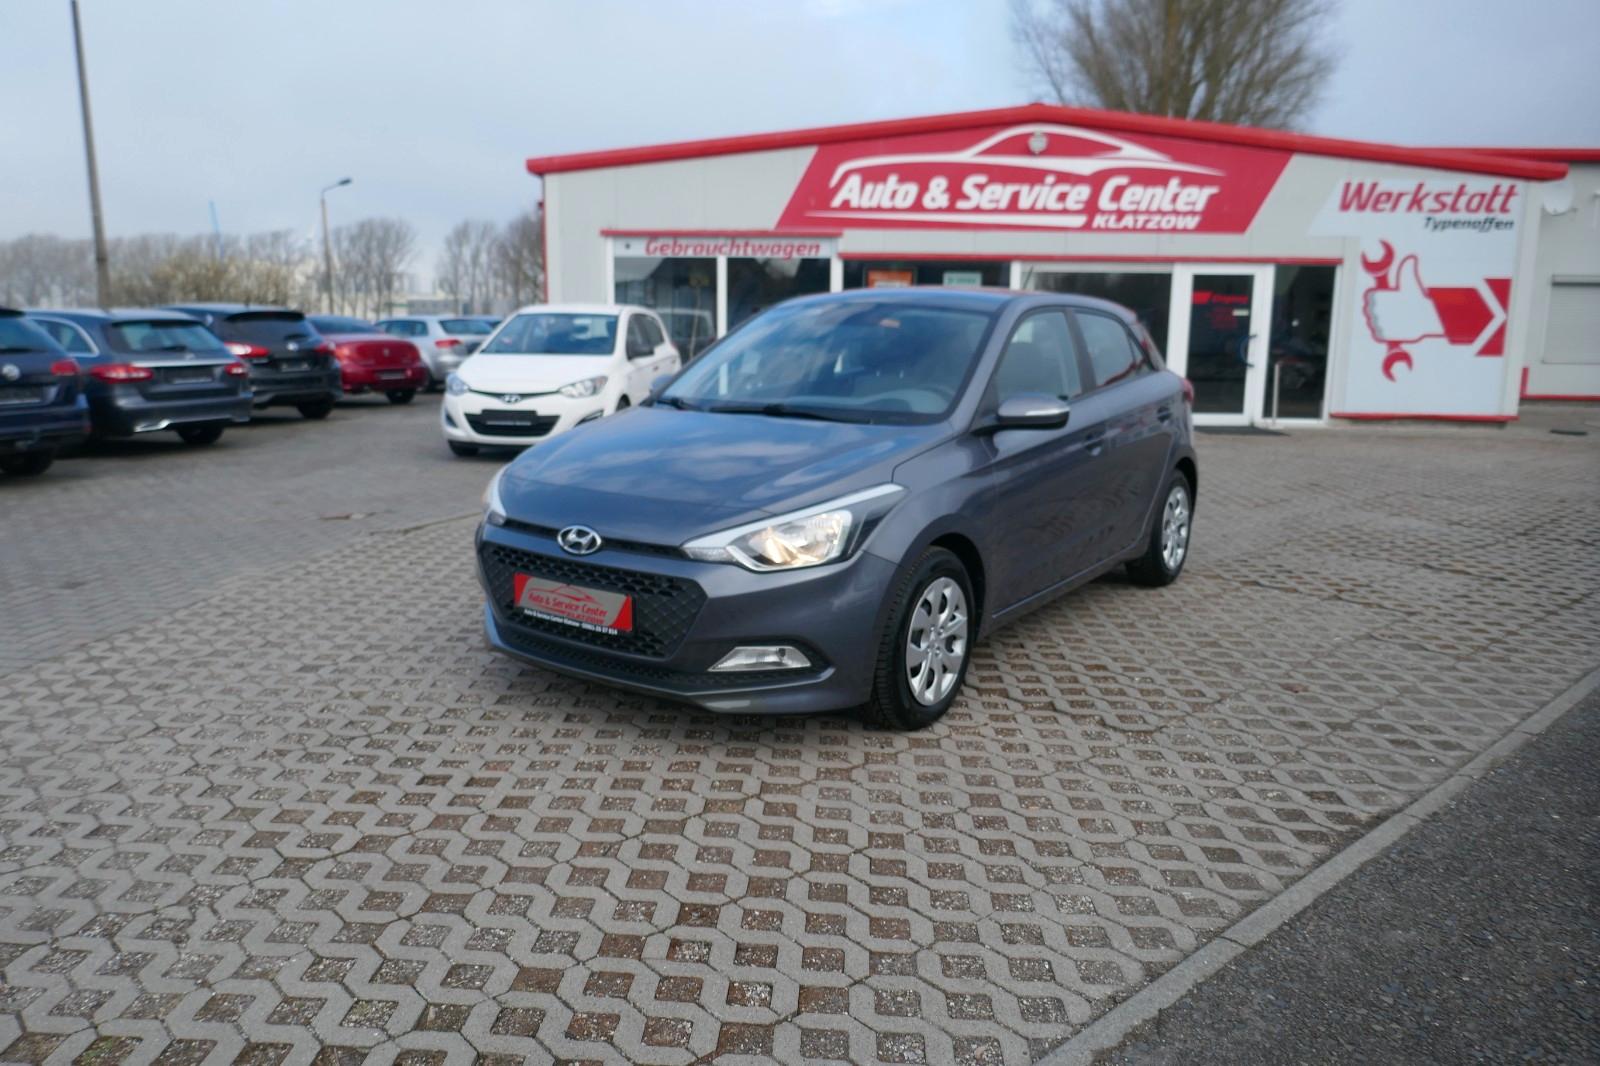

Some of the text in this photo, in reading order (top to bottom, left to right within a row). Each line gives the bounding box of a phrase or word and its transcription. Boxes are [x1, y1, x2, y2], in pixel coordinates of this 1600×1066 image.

[830, 173, 1221, 212] Auto & Service Center
[1338, 181, 1519, 214] Werkstatt
[1092, 214, 1201, 231] KLATZOW
[1424, 216, 1515, 233] Typenoffen
[644, 238, 821, 260] Gebrauchtwagen
